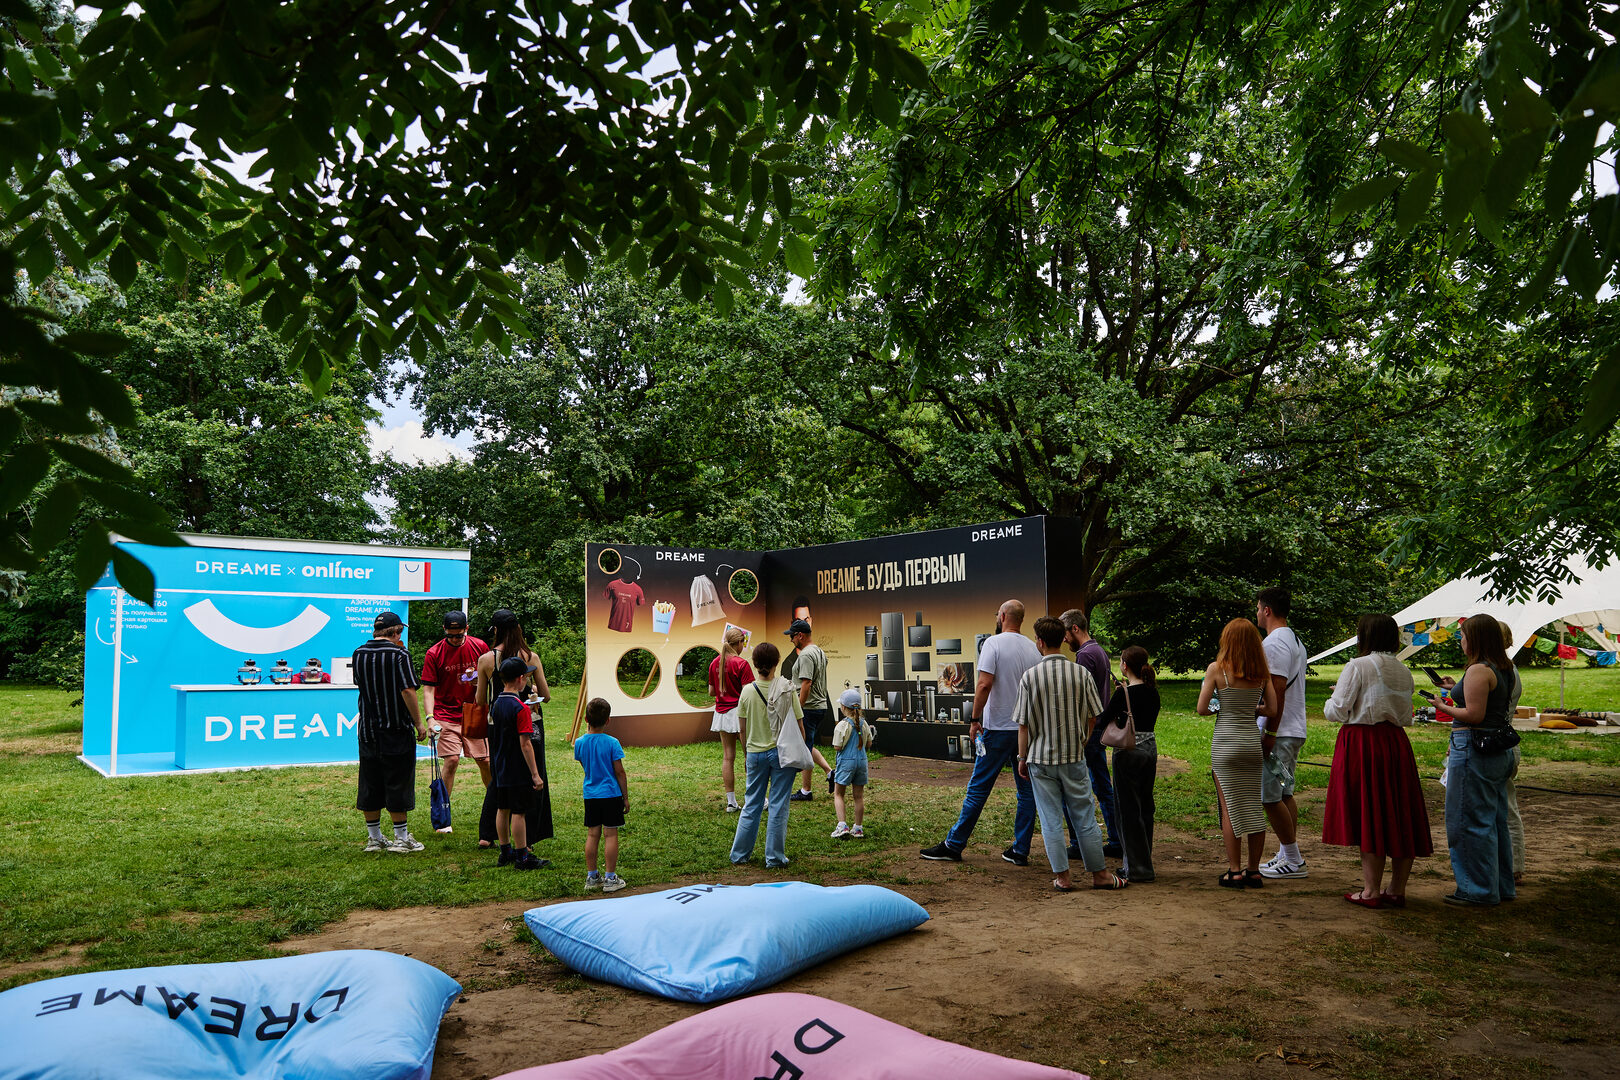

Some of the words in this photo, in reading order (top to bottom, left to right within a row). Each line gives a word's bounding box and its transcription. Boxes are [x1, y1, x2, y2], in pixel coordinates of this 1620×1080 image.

[971, 524, 1023, 542] DREAME
[195, 560, 282, 576] DREAME
[655, 551, 706, 563] DREAME
[816, 565, 865, 595] DREAME.
[867, 562, 902, 592] БУДЬ
[905, 552, 966, 587] ПЕРВЫМ
[204, 712, 360, 742] DREAM
[35, 984, 350, 1042] DREAME
